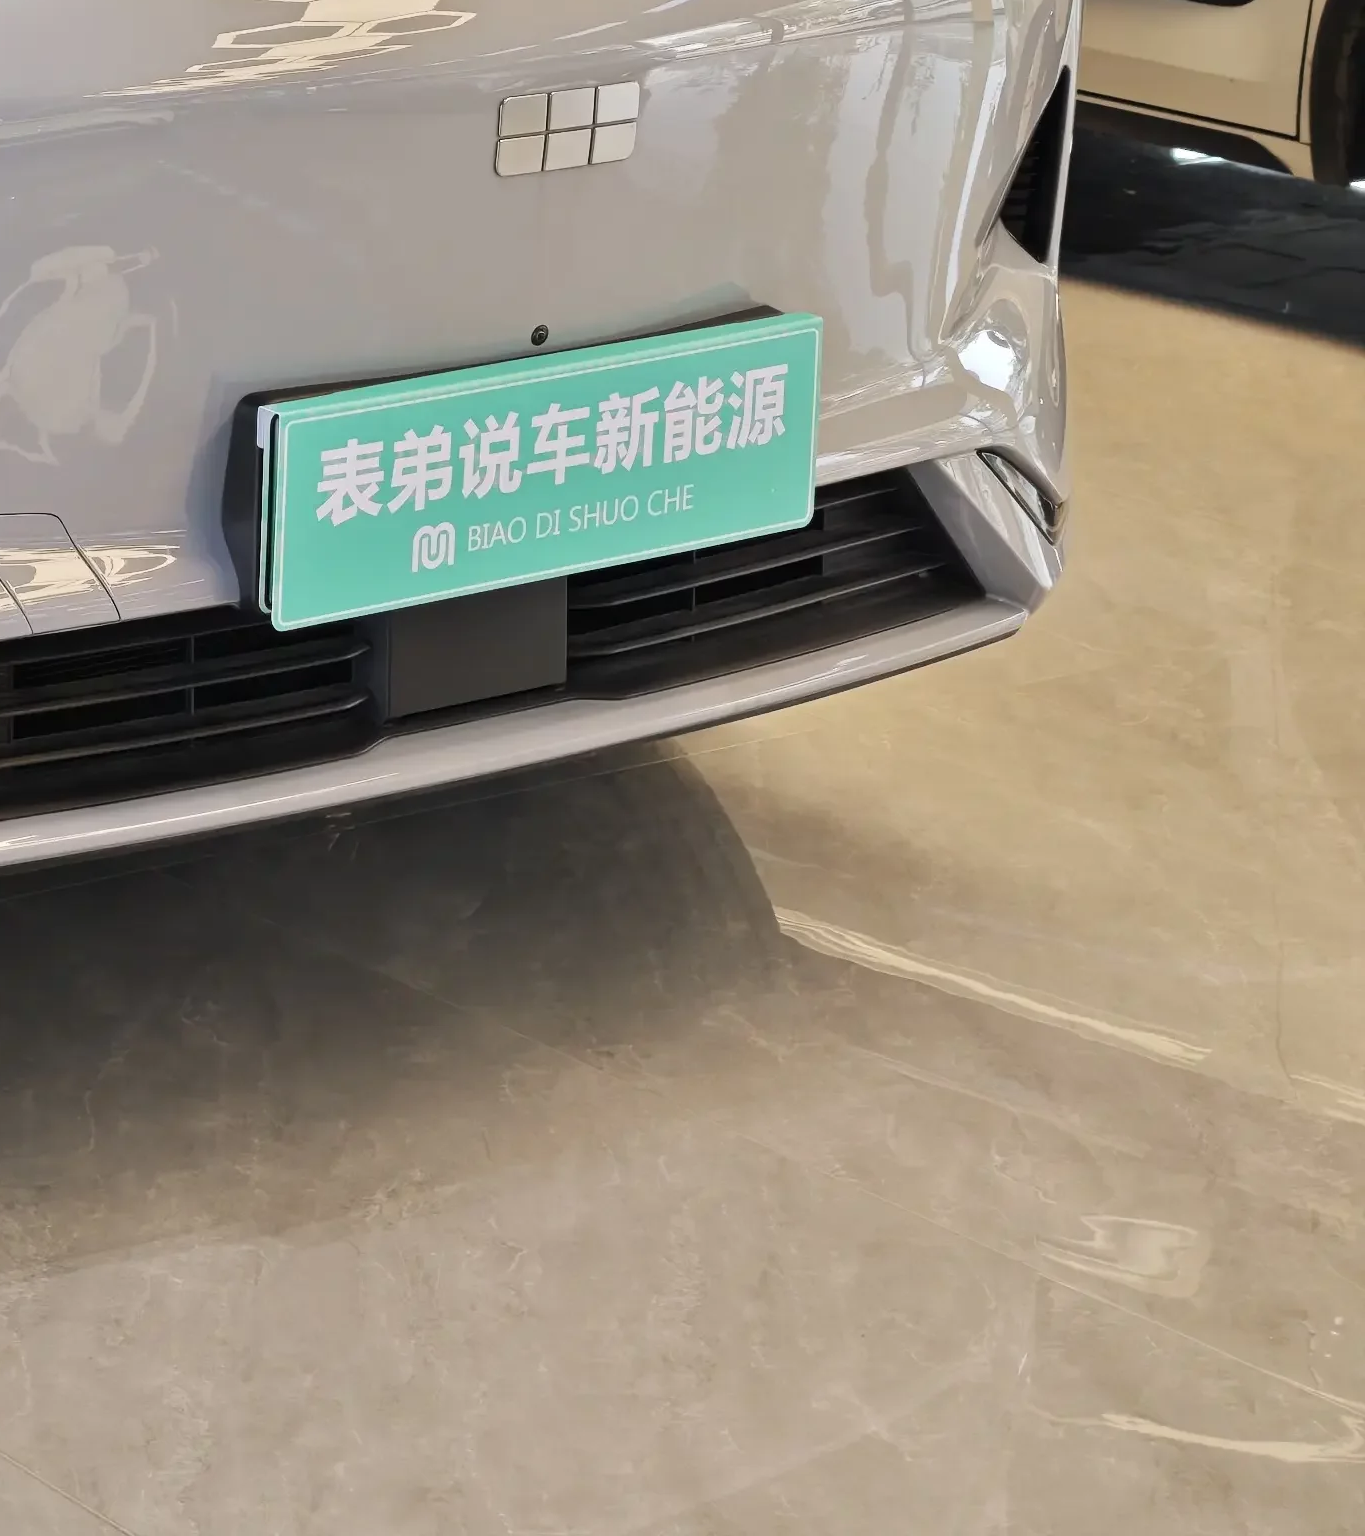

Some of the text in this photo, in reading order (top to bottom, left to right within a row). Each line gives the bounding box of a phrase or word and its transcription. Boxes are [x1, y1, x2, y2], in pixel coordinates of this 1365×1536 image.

[315, 364, 789, 527] 表弟说车新能源
[468, 484, 694, 552] BIAO DI SHUO CHE
